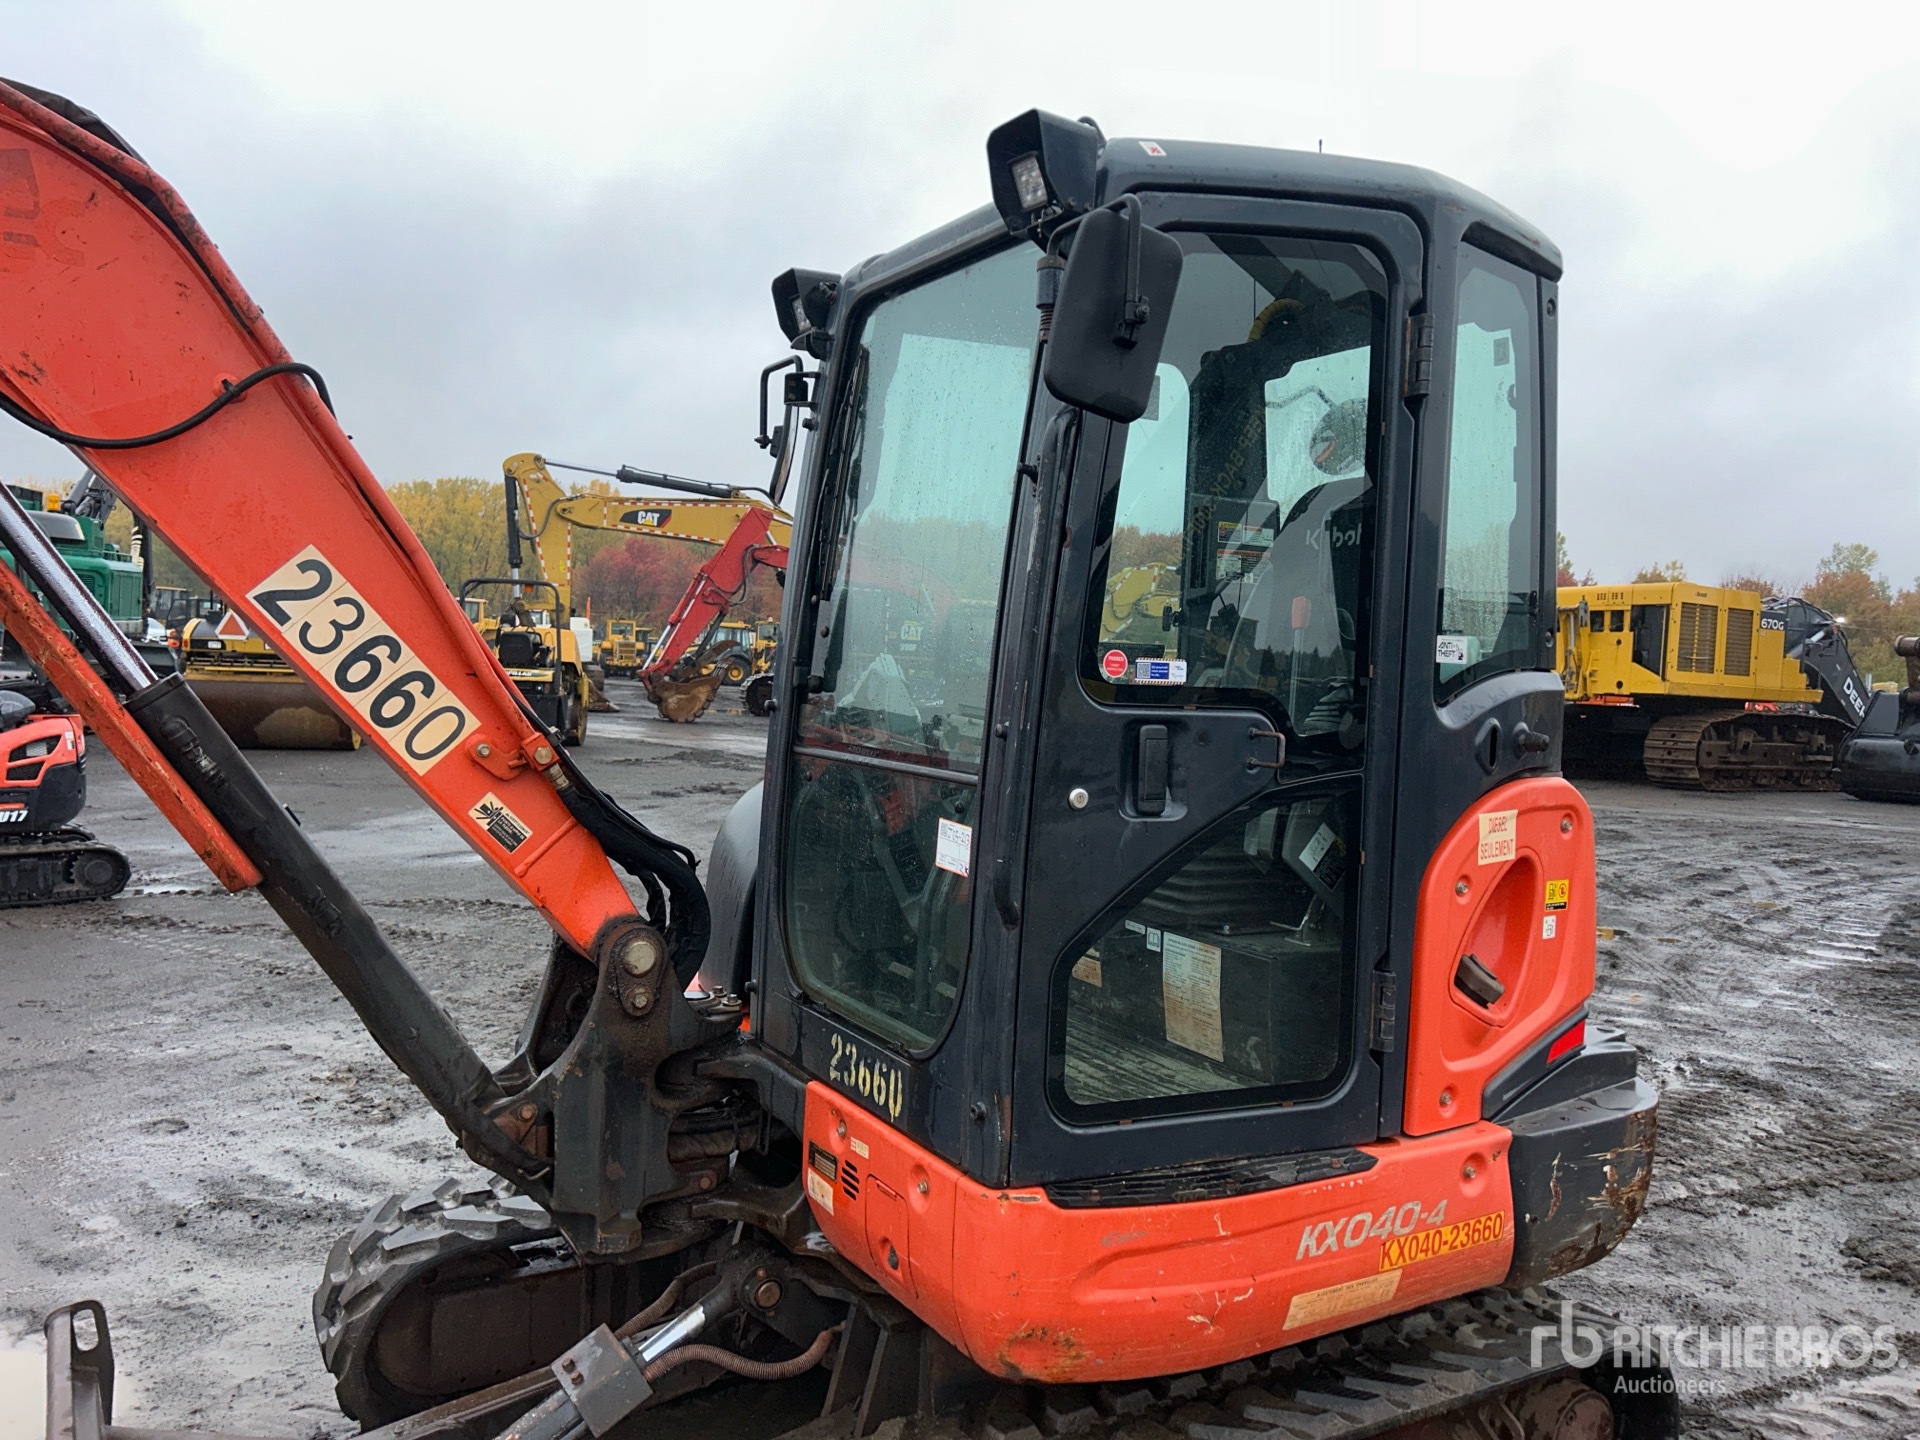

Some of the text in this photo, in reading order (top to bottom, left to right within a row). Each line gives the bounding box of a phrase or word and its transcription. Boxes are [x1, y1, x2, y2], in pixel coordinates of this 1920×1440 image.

[637, 510, 660, 527] CAT
[900, 625, 923, 641] CAT
[1761, 618, 1785, 631] 670G
[252, 558, 466, 761] 23660
[1843, 676, 1866, 719] DEE
[1480, 838, 1514, 860] SEULEMENT
[829, 1032, 903, 1122] 23660
[1296, 1200, 1447, 1260] KX040-4
[1380, 1212, 1503, 1270] KX040-23660
